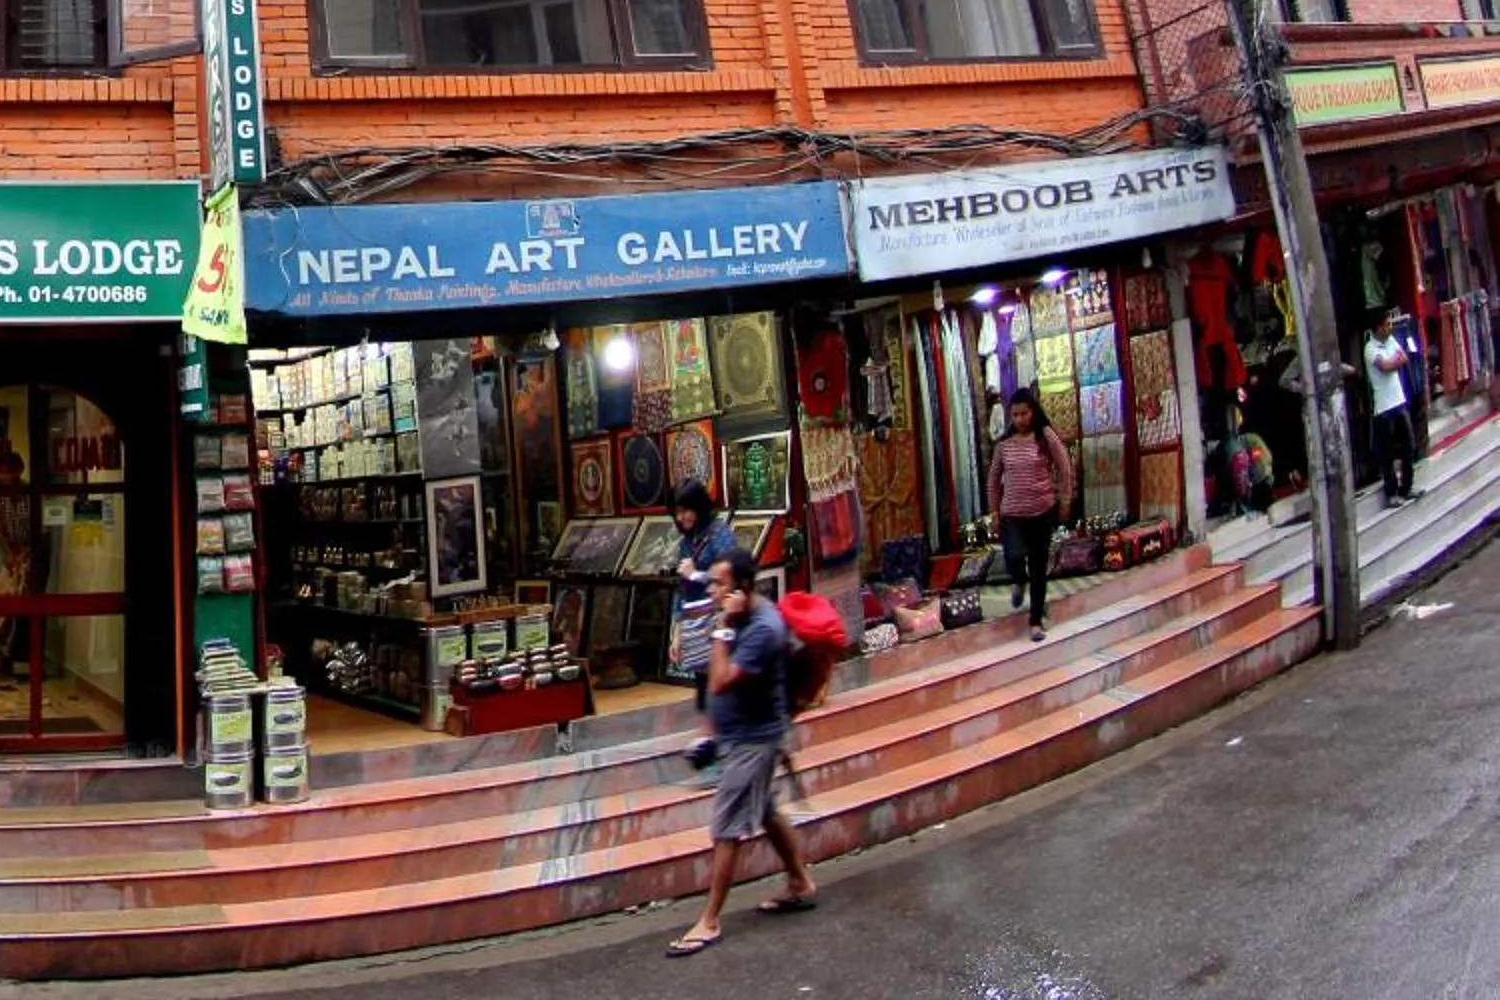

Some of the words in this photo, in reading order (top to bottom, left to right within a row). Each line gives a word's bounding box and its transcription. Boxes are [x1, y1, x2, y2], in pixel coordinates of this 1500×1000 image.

[233, 36, 255, 168] LODGE
[867, 179, 1094, 230] MEHBOOB
[1108, 159, 1217, 198] ARTS
[32, 239, 184, 275] LODGE
[297, 244, 456, 285] NEPAL
[484, 237, 585, 275] ART
[616, 220, 809, 266] GALLERY
